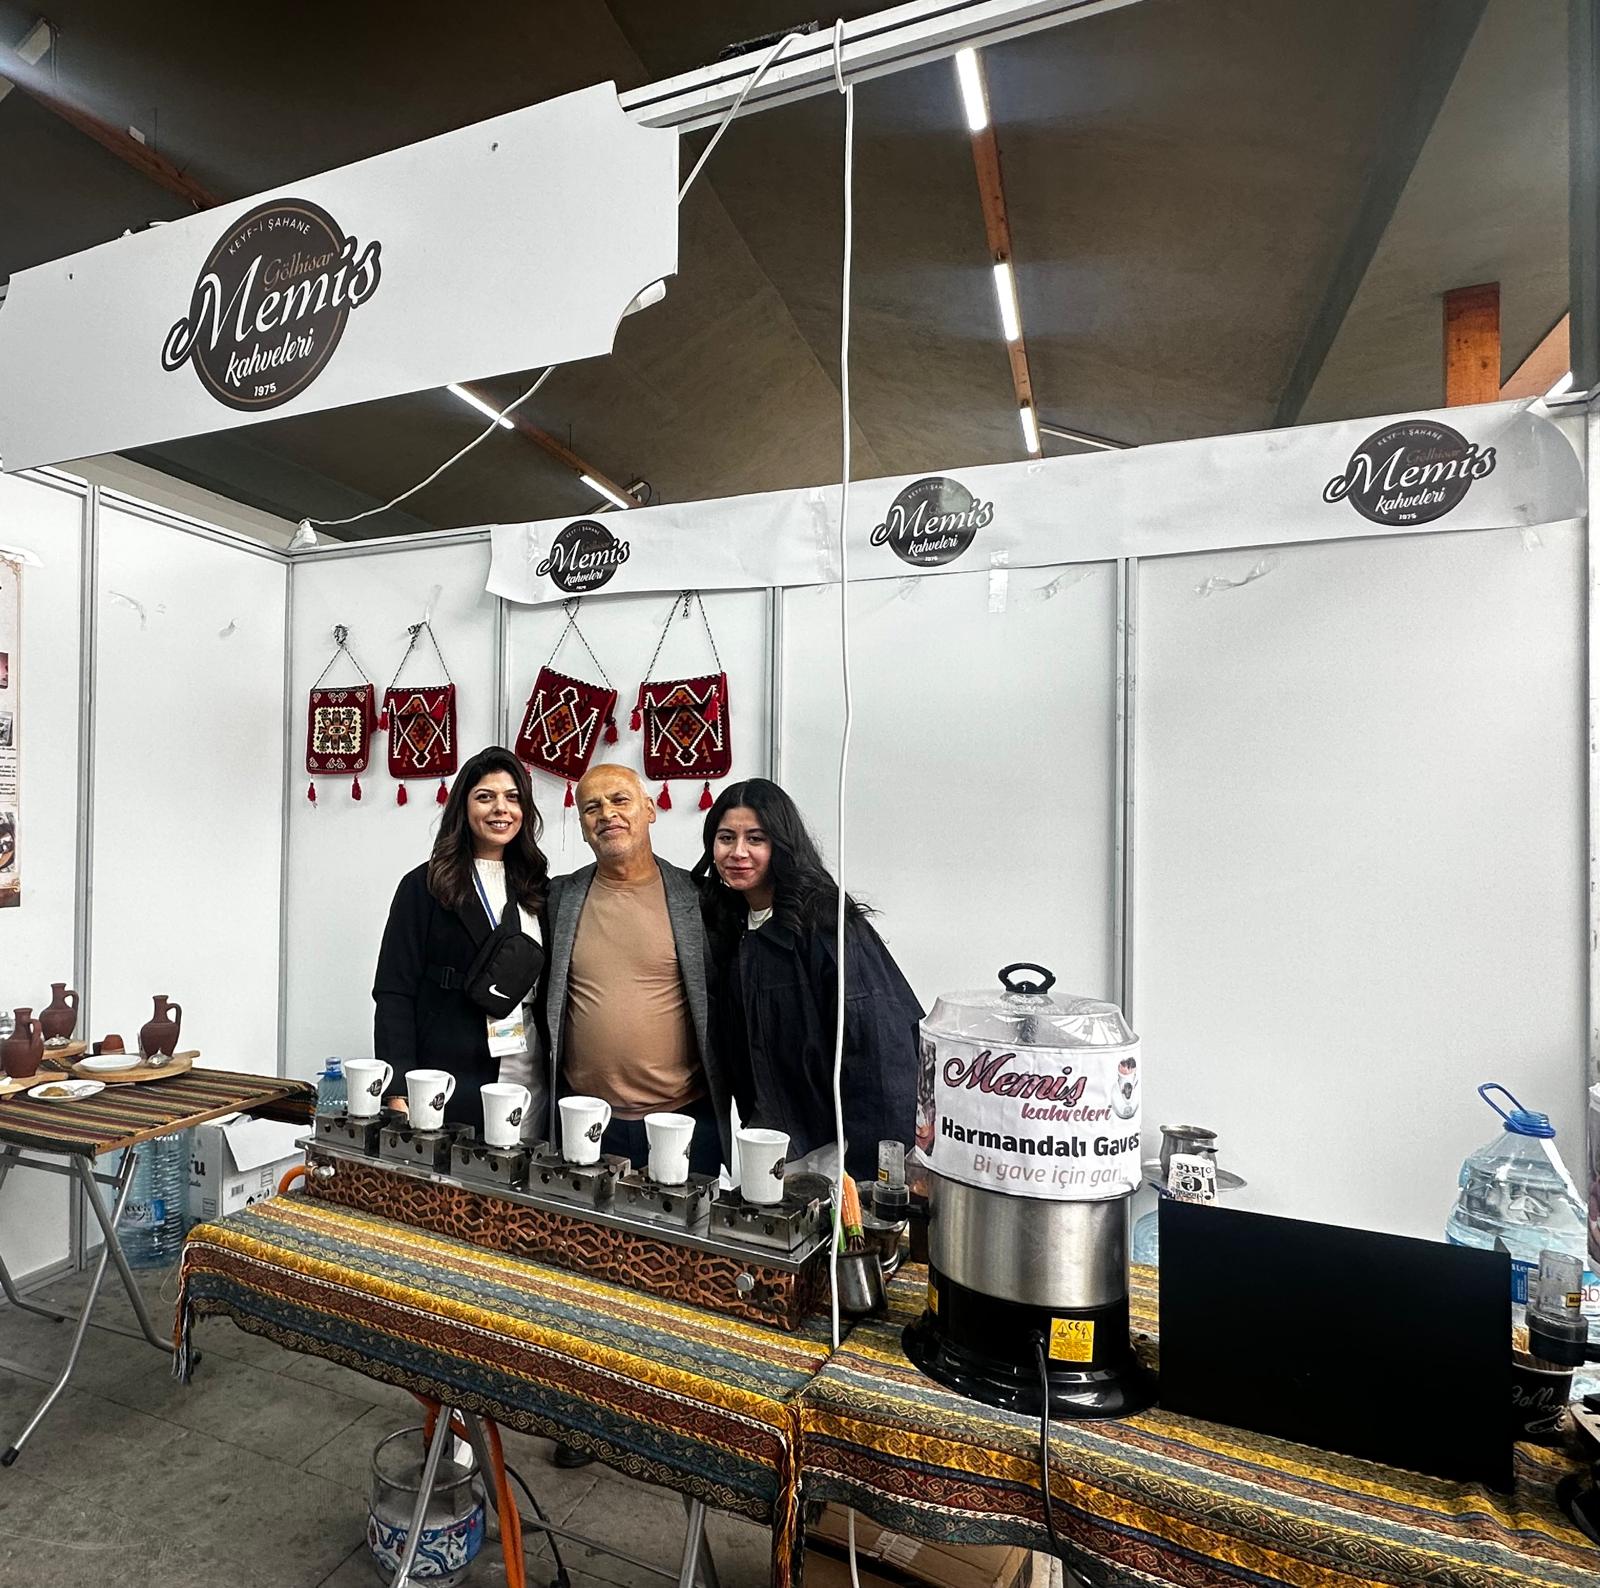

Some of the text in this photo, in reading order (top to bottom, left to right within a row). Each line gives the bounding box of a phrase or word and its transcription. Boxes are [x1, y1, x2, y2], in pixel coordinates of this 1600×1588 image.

[268, 217, 311, 235] ŞAHANE
[263, 251, 334, 292] Gölhisar
[163, 242, 377, 367] Memiş
[225, 327, 314, 388] kahveleri
[254, 382, 277, 397] 1975
[1374, 486, 1446, 515] kahveleri
[908, 534, 959, 557] kahveleri
[564, 568, 604, 586] kahveleri
[942, 1050, 1088, 1107] Memiş
[1020, 1103, 1113, 1122] kahveleri
[941, 1116, 1087, 1158] Harmandalı
[973, 1154, 990, 1173] Bi
[996, 1162, 1046, 1181] gave
[1052, 1165, 1086, 1189] için
